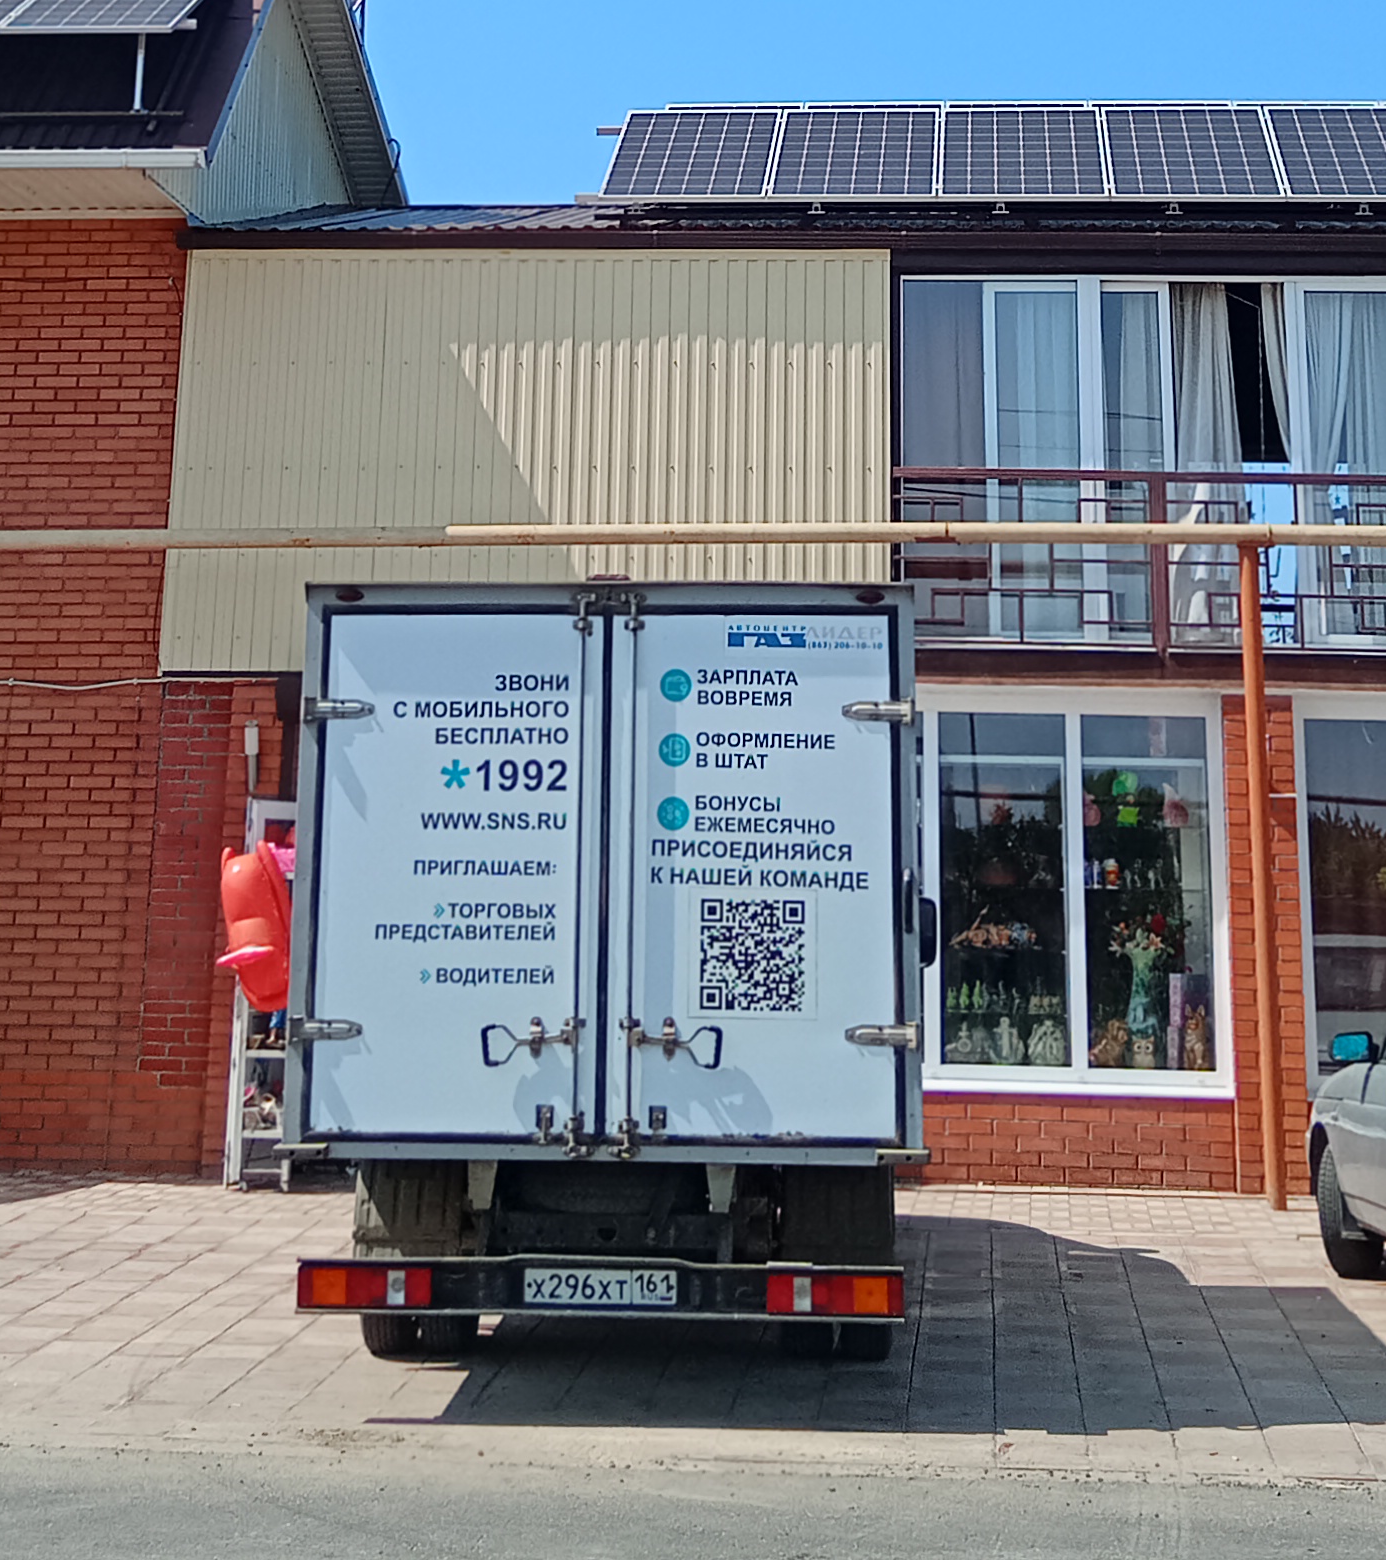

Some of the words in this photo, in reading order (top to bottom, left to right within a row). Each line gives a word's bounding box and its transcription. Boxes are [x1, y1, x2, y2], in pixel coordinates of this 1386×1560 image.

[728, 624, 807, 632] АВТОЦЕНТР
[807, 626, 882, 640] ЛИДЕР
[727, 632, 807, 648] ГАЗ
[494, 674, 570, 692] ЗВОНИ
[696, 668, 799, 687] ЗАРПЛАТА
[696, 689, 793, 707] ВОВРЕМЯ
[392, 700, 408, 719] С
[414, 700, 570, 719] МОБИЛЬНОГО
[435, 727, 569, 745] БЕСПЛАТНО
[695, 731, 836, 750] ОФОРМЛЕНИЕ
[695, 752, 709, 768] В
[714, 752, 769, 770] ШТАТ
[695, 795, 781, 813] БОНУСЫ
[420, 812, 567, 831] WWW.SNS.RU
[694, 816, 836, 836] ЕЖЕМЕСЯЧНО
[650, 838, 853, 863] ПРИСОЕДИНЯЙСЯ
[413, 859, 558, 877] ПРИГЛАШАЕМ:
[650, 866, 664, 885] К
[669, 864, 752, 887] НАШЕЙ
[759, 870, 869, 893] КОМАНДЕ
[447, 903, 556, 920] ТОРГОВЫХ
[374, 921, 556, 943] ПРЕДСТАВИТЕЛЕЙ
[435, 965, 555, 986] ВОДИТЕЛЕЙ
[532, 1273, 628, 1300] Х296ХТ
[634, 1273, 672, 1293] 161
